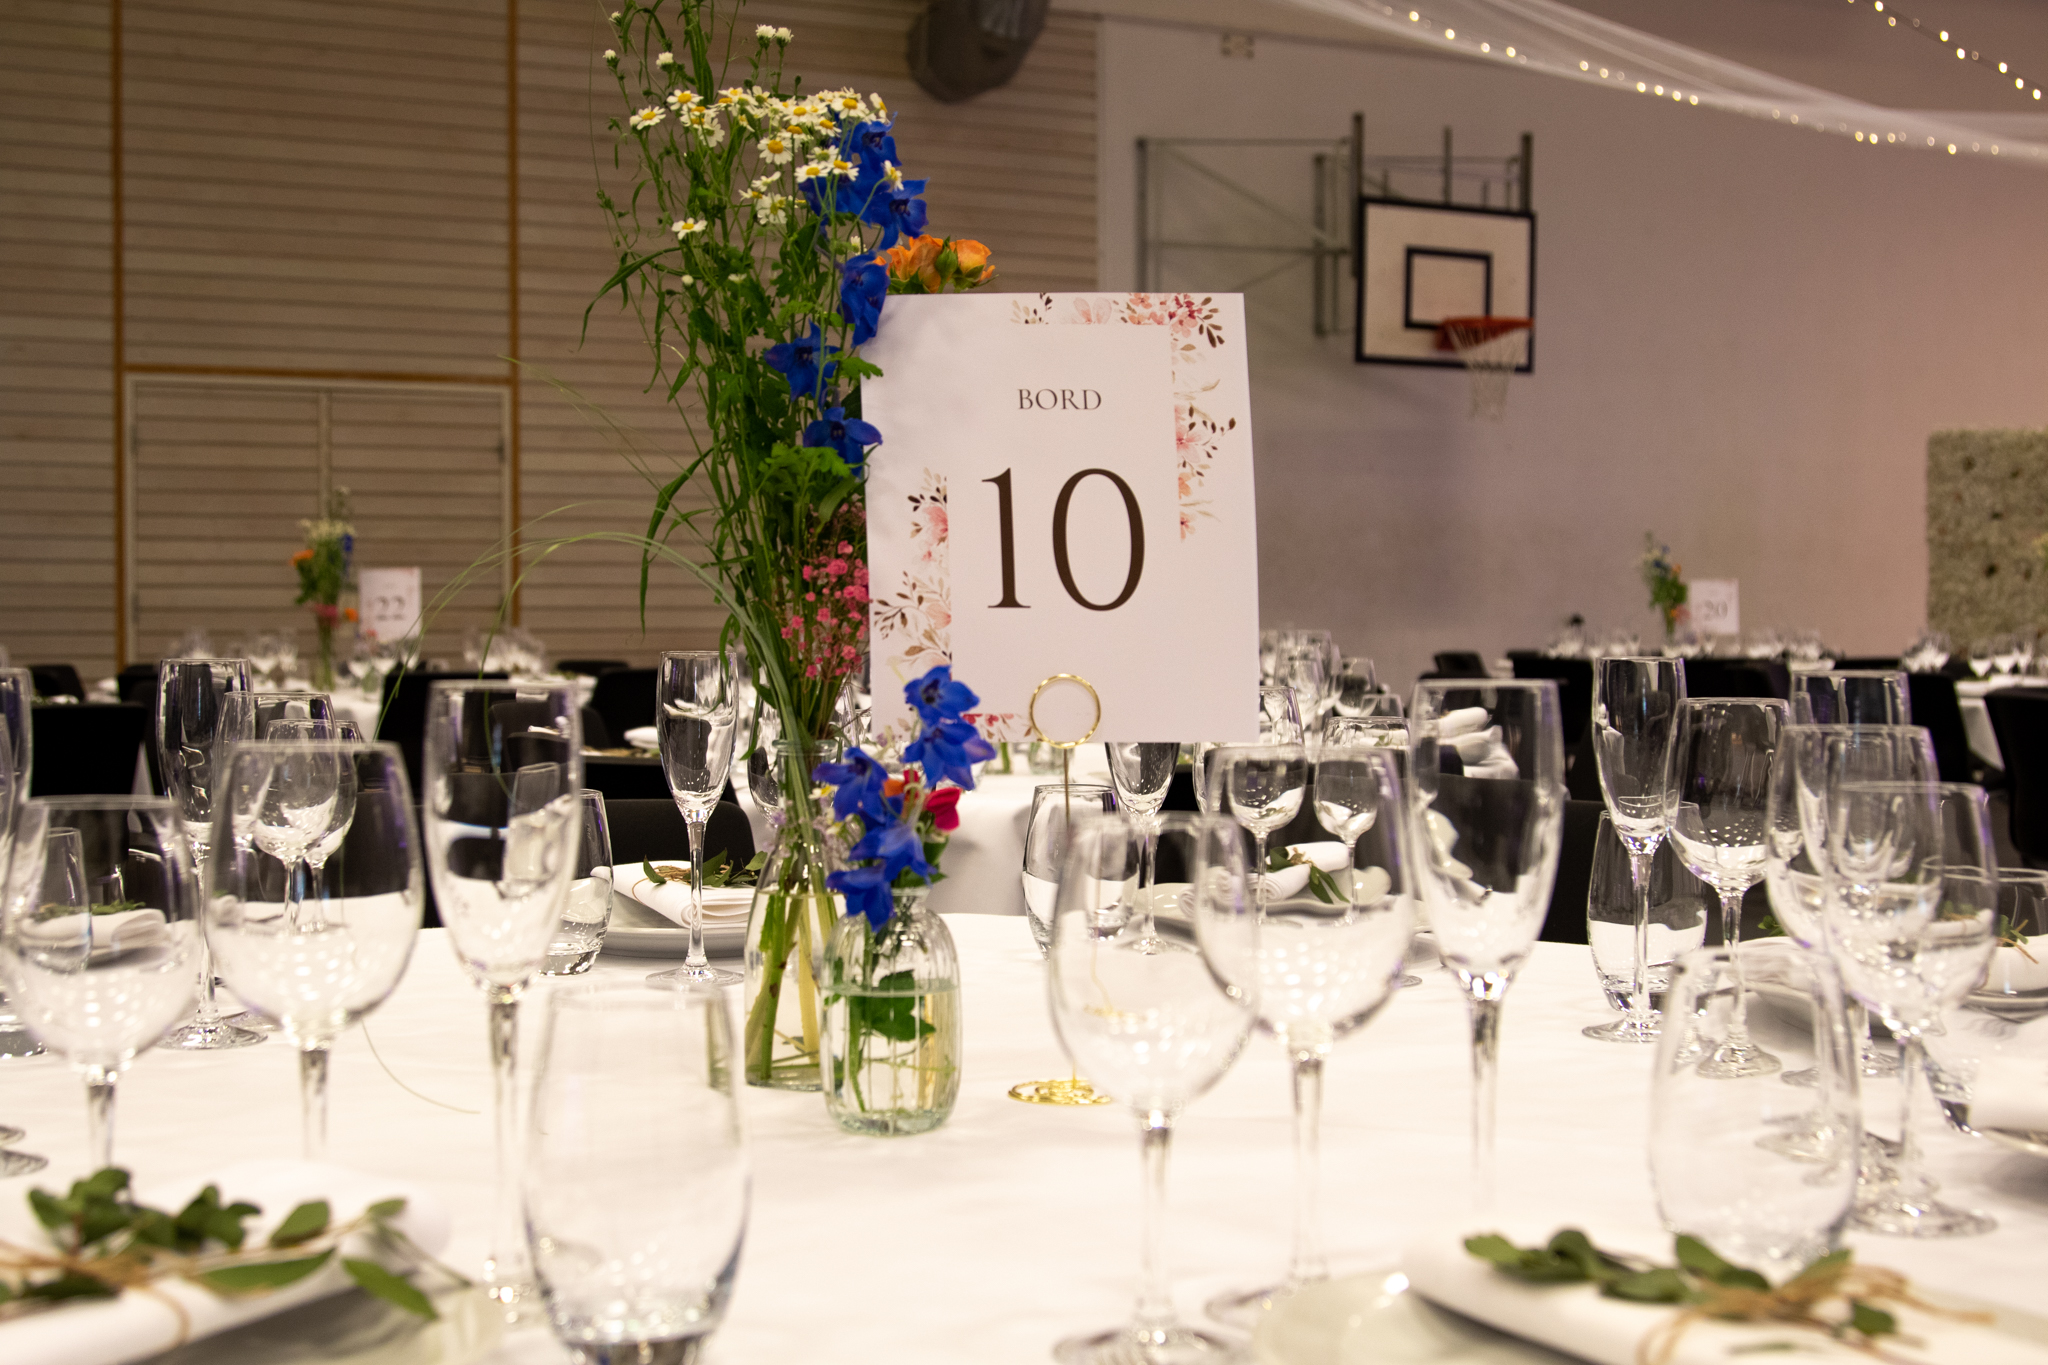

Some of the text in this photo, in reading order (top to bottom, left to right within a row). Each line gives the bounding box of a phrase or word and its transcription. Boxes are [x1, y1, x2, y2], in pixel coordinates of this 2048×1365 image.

[1017, 388, 1102, 411] BORD
[981, 467, 1145, 612] 10
[1704, 599, 1728, 622] 20
